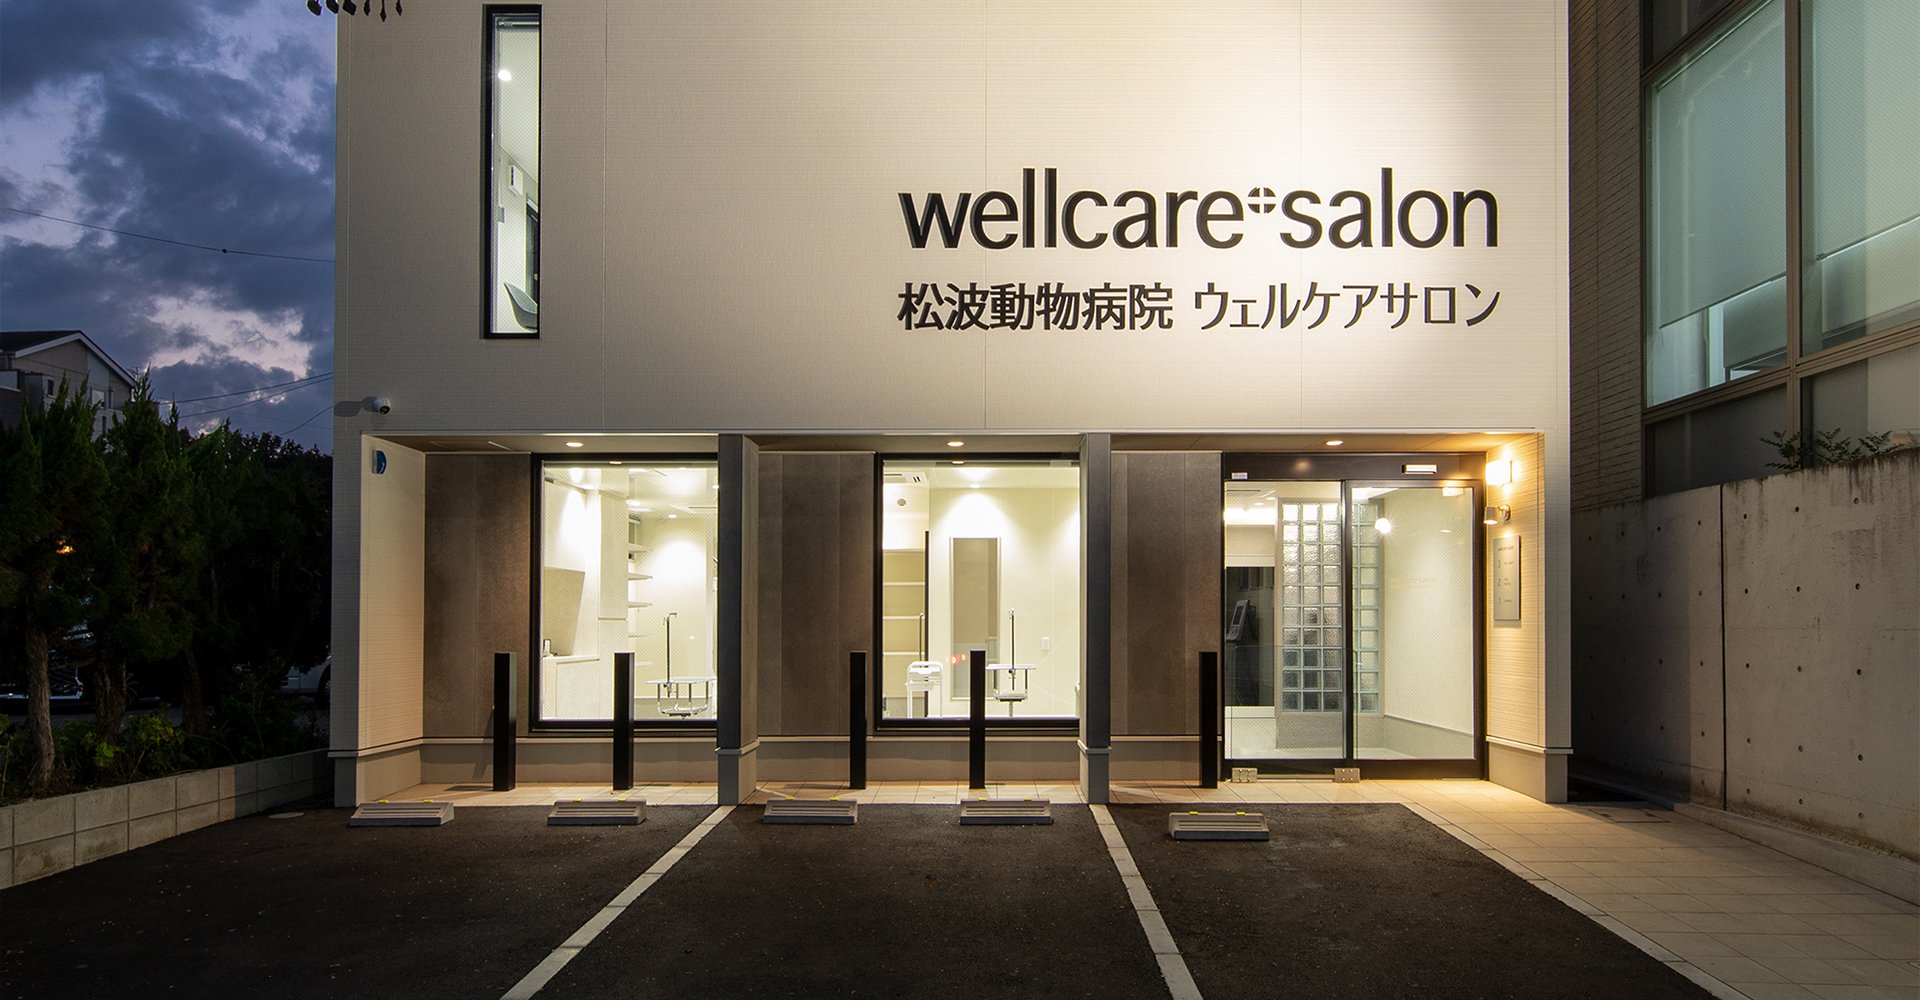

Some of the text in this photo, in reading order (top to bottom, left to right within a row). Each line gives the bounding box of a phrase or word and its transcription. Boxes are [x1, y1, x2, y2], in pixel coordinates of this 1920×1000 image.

[897, 167, 1498, 249] wellcare salon
[896, 281, 1501, 331] 松波動物病院 ウェルケアサロン
